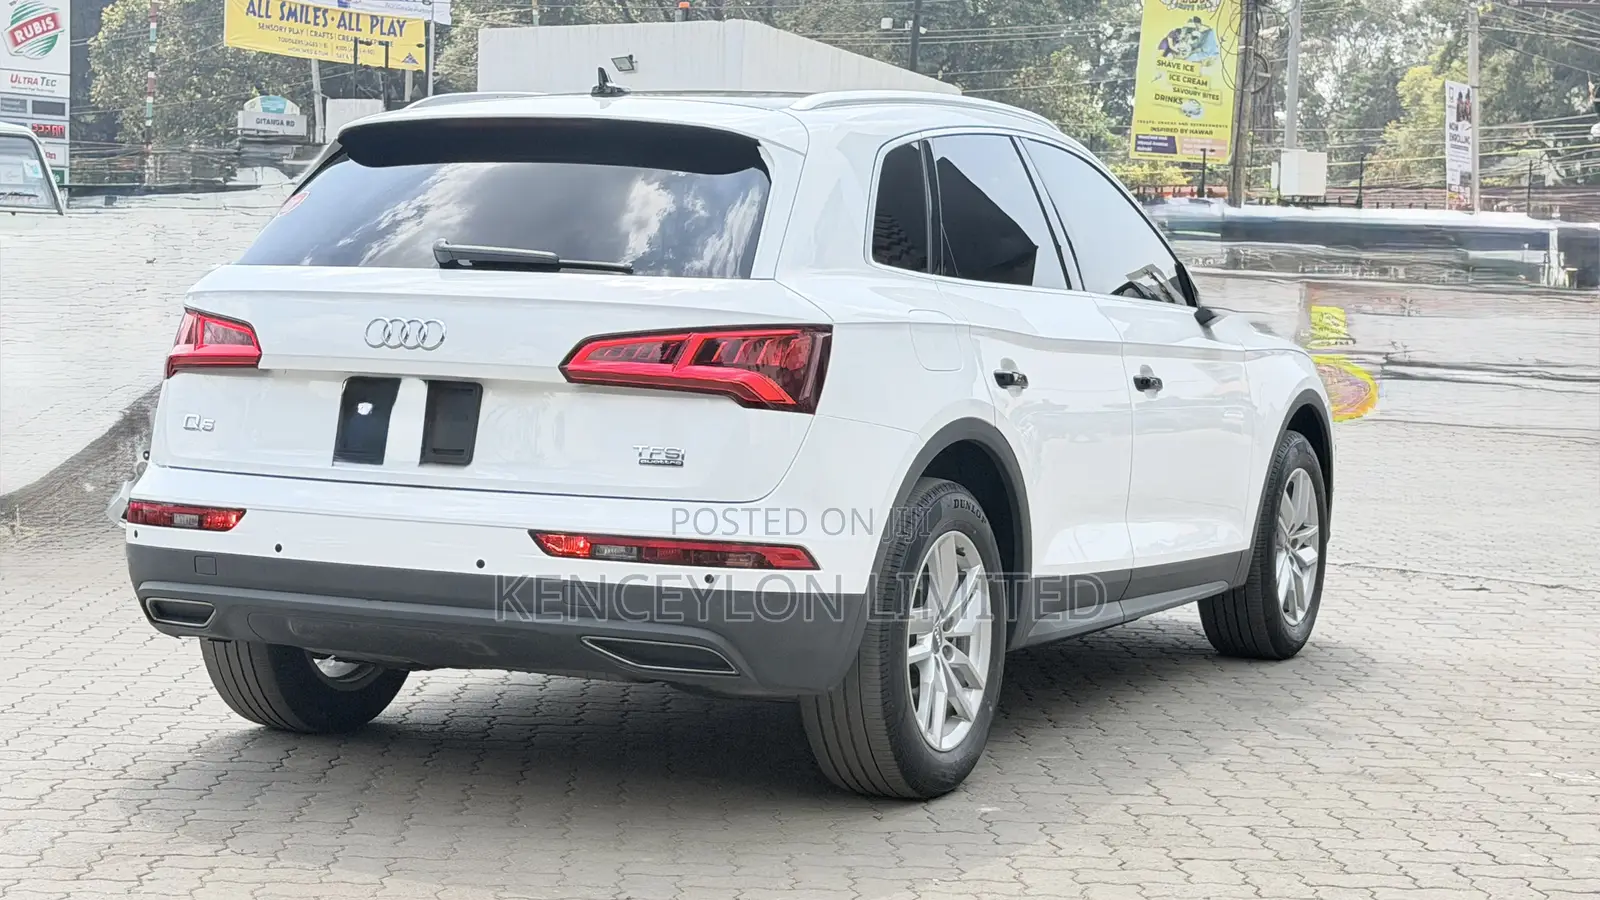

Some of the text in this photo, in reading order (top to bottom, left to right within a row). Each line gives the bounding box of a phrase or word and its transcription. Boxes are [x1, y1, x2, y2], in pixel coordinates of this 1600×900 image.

[246, 0, 406, 37] ALL SMILES ALL PLAY
[14, 16, 55, 43] RUBIS
[257, 22, 287, 33] SENSORY
[288, 28, 304, 36] PLAY
[310, 30, 333, 40] CRAFTS
[1157, 59, 1195, 72] SHAVE ICE
[10, 73, 57, 87] ULTRA TEC
[1169, 74, 1208, 87] ICE CREAM
[1154, 93, 1183, 105] DRINKS
[1172, 86, 1219, 101] SAVOURY BITES
[256, 117, 285, 127] GITANGA
[1150, 126, 1179, 134] INSPIRED
[183, 413, 216, 432] Q5
[632, 445, 685, 461] TFSI
[953, 499, 987, 524] DUNLOP
